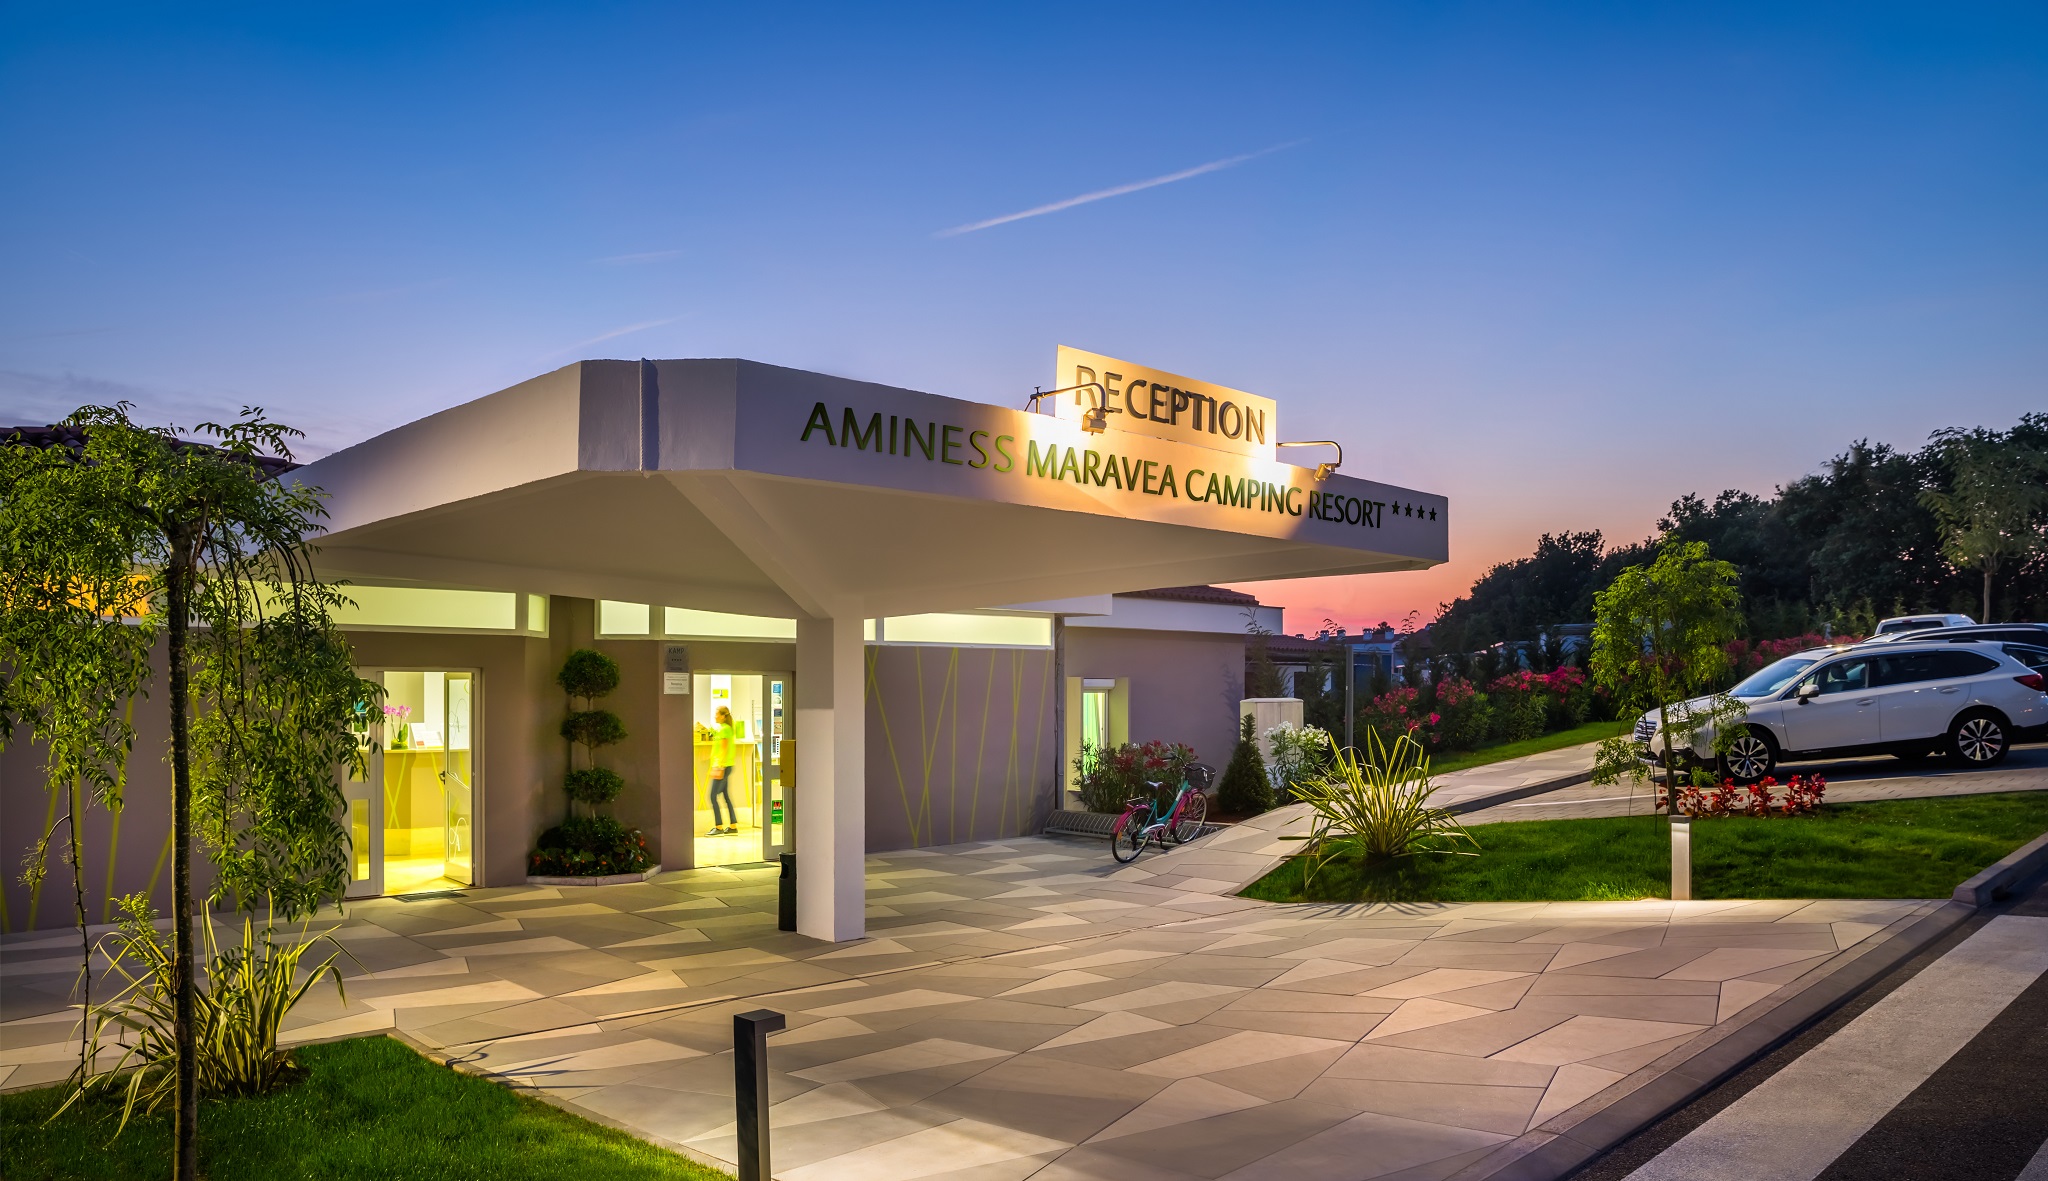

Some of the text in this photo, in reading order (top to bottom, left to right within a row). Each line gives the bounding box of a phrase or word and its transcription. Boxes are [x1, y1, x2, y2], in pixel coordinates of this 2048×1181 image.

[1075, 365, 1266, 445] RECEPTION
[800, 402, 1386, 529] AMINESS MARAVEA CAMPING RESORT
[668, 647, 685, 655] KAMP
